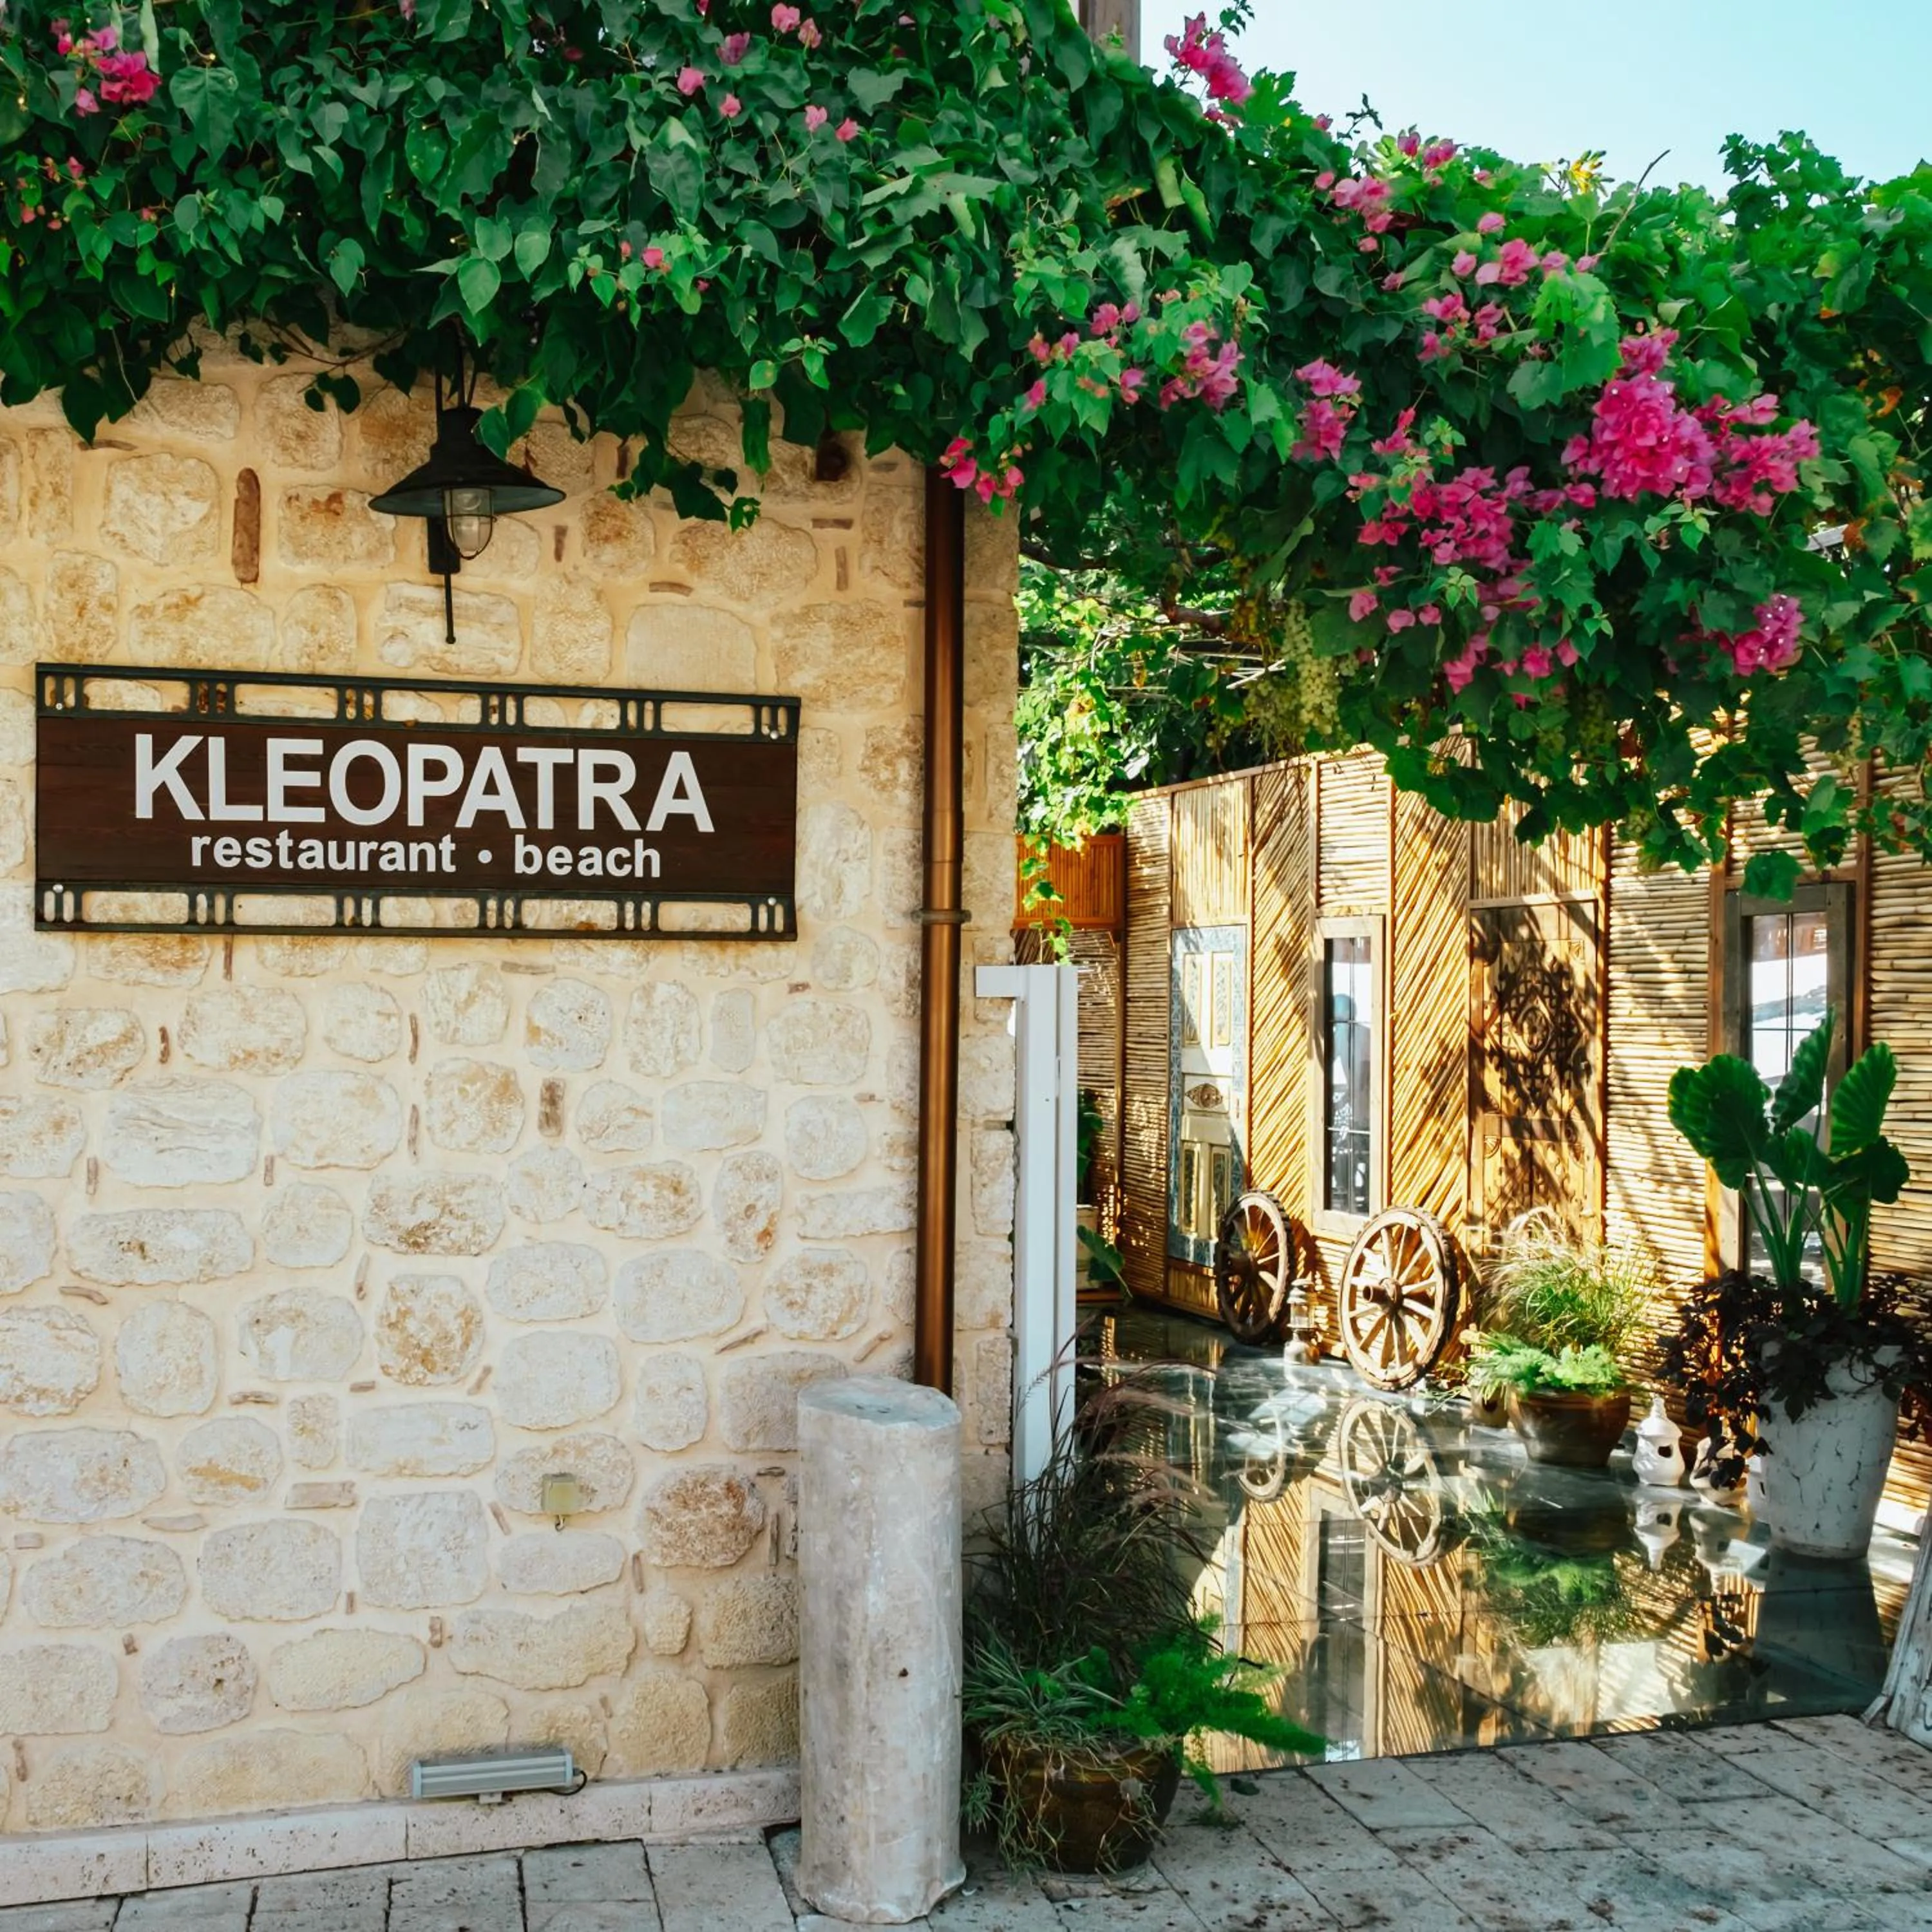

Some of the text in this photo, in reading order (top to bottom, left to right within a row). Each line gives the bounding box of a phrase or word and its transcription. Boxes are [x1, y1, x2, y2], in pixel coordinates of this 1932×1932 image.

[135, 734, 715, 833] KLEOPATRA
[191, 829, 660, 878] restaurant beach
